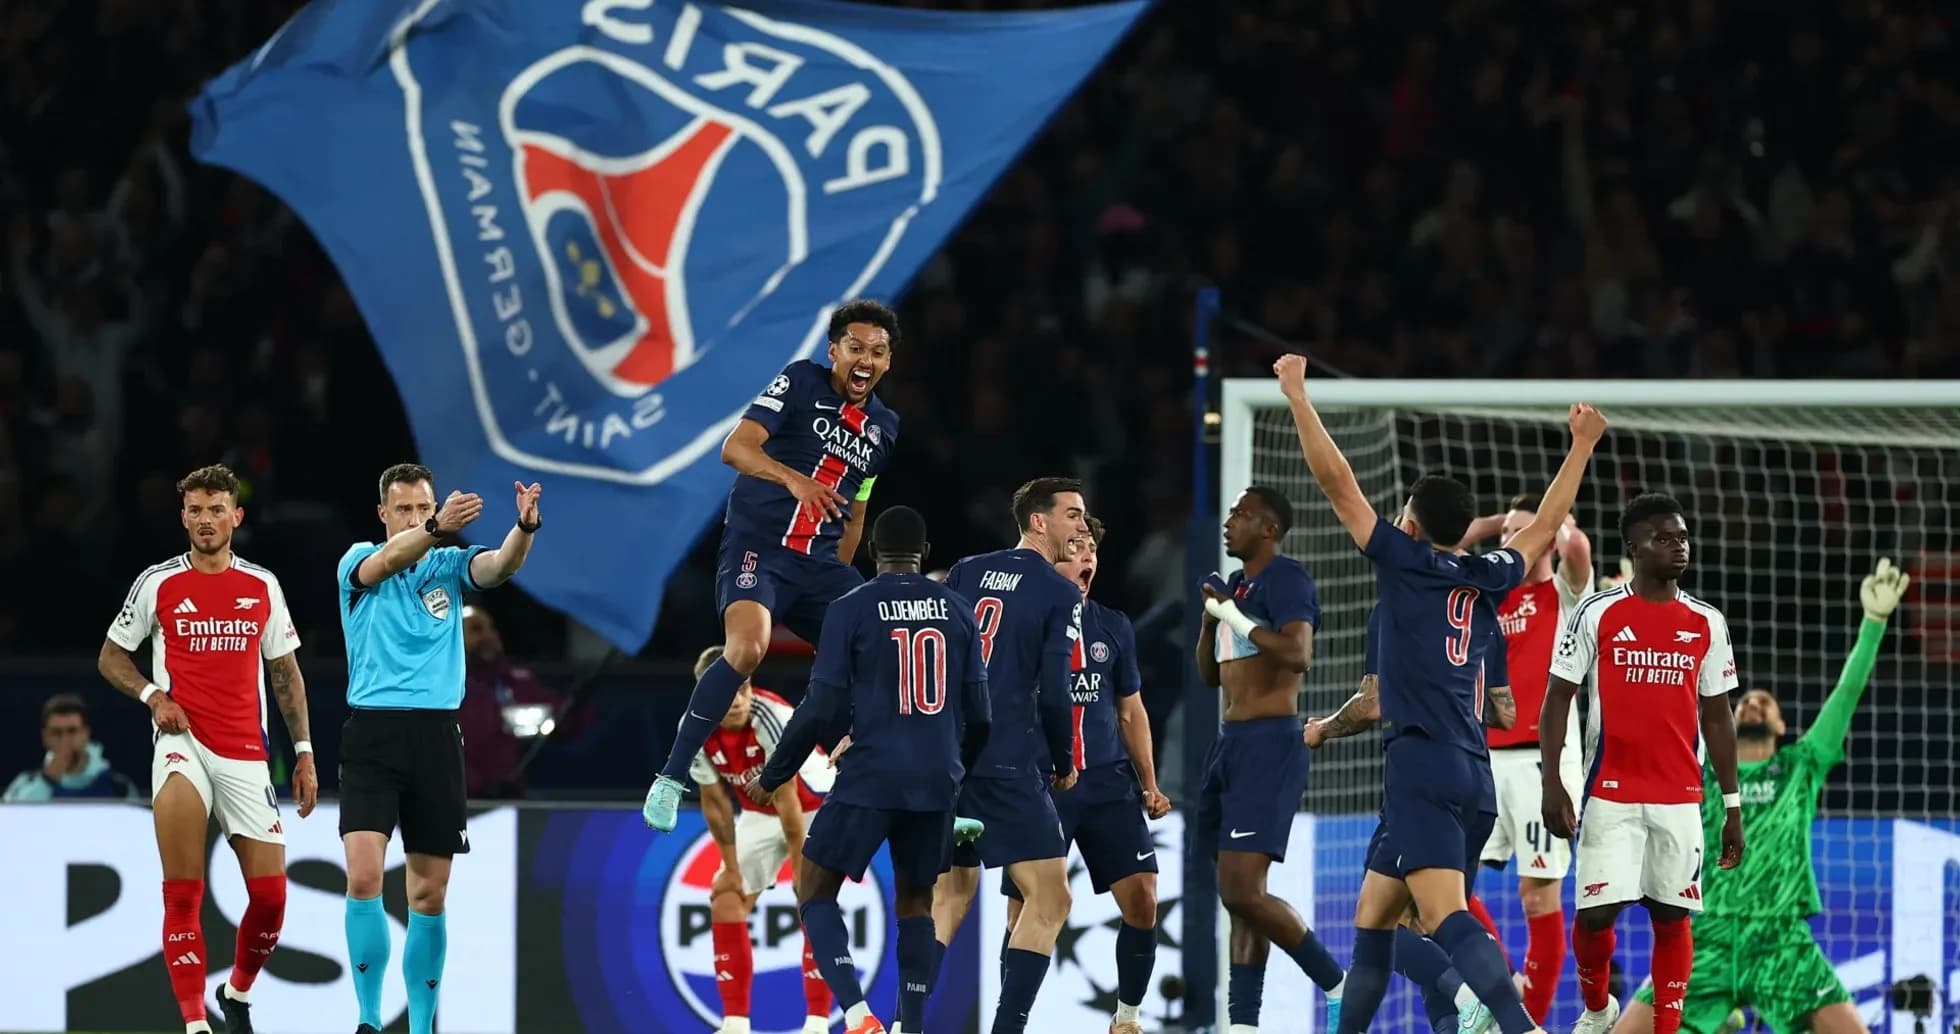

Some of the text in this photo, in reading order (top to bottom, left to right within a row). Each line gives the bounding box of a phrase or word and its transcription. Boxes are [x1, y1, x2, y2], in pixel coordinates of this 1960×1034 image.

[812, 417, 873, 462] QATAR
[823, 441, 870, 473] AIRWAYS
[741, 550, 758, 573] 5
[979, 570, 1023, 591] FABIAN
[175, 617, 259, 636] Emirates
[1446, 586, 1481, 666] 9
[190, 637, 248, 652] FLY BETTER
[1612, 647, 1696, 671] Emirates
[890, 627, 947, 715] 10
[1625, 667, 1684, 686] FLY BETTER
[1526, 821, 1550, 852] 41
[168, 932, 197, 942] AFC
